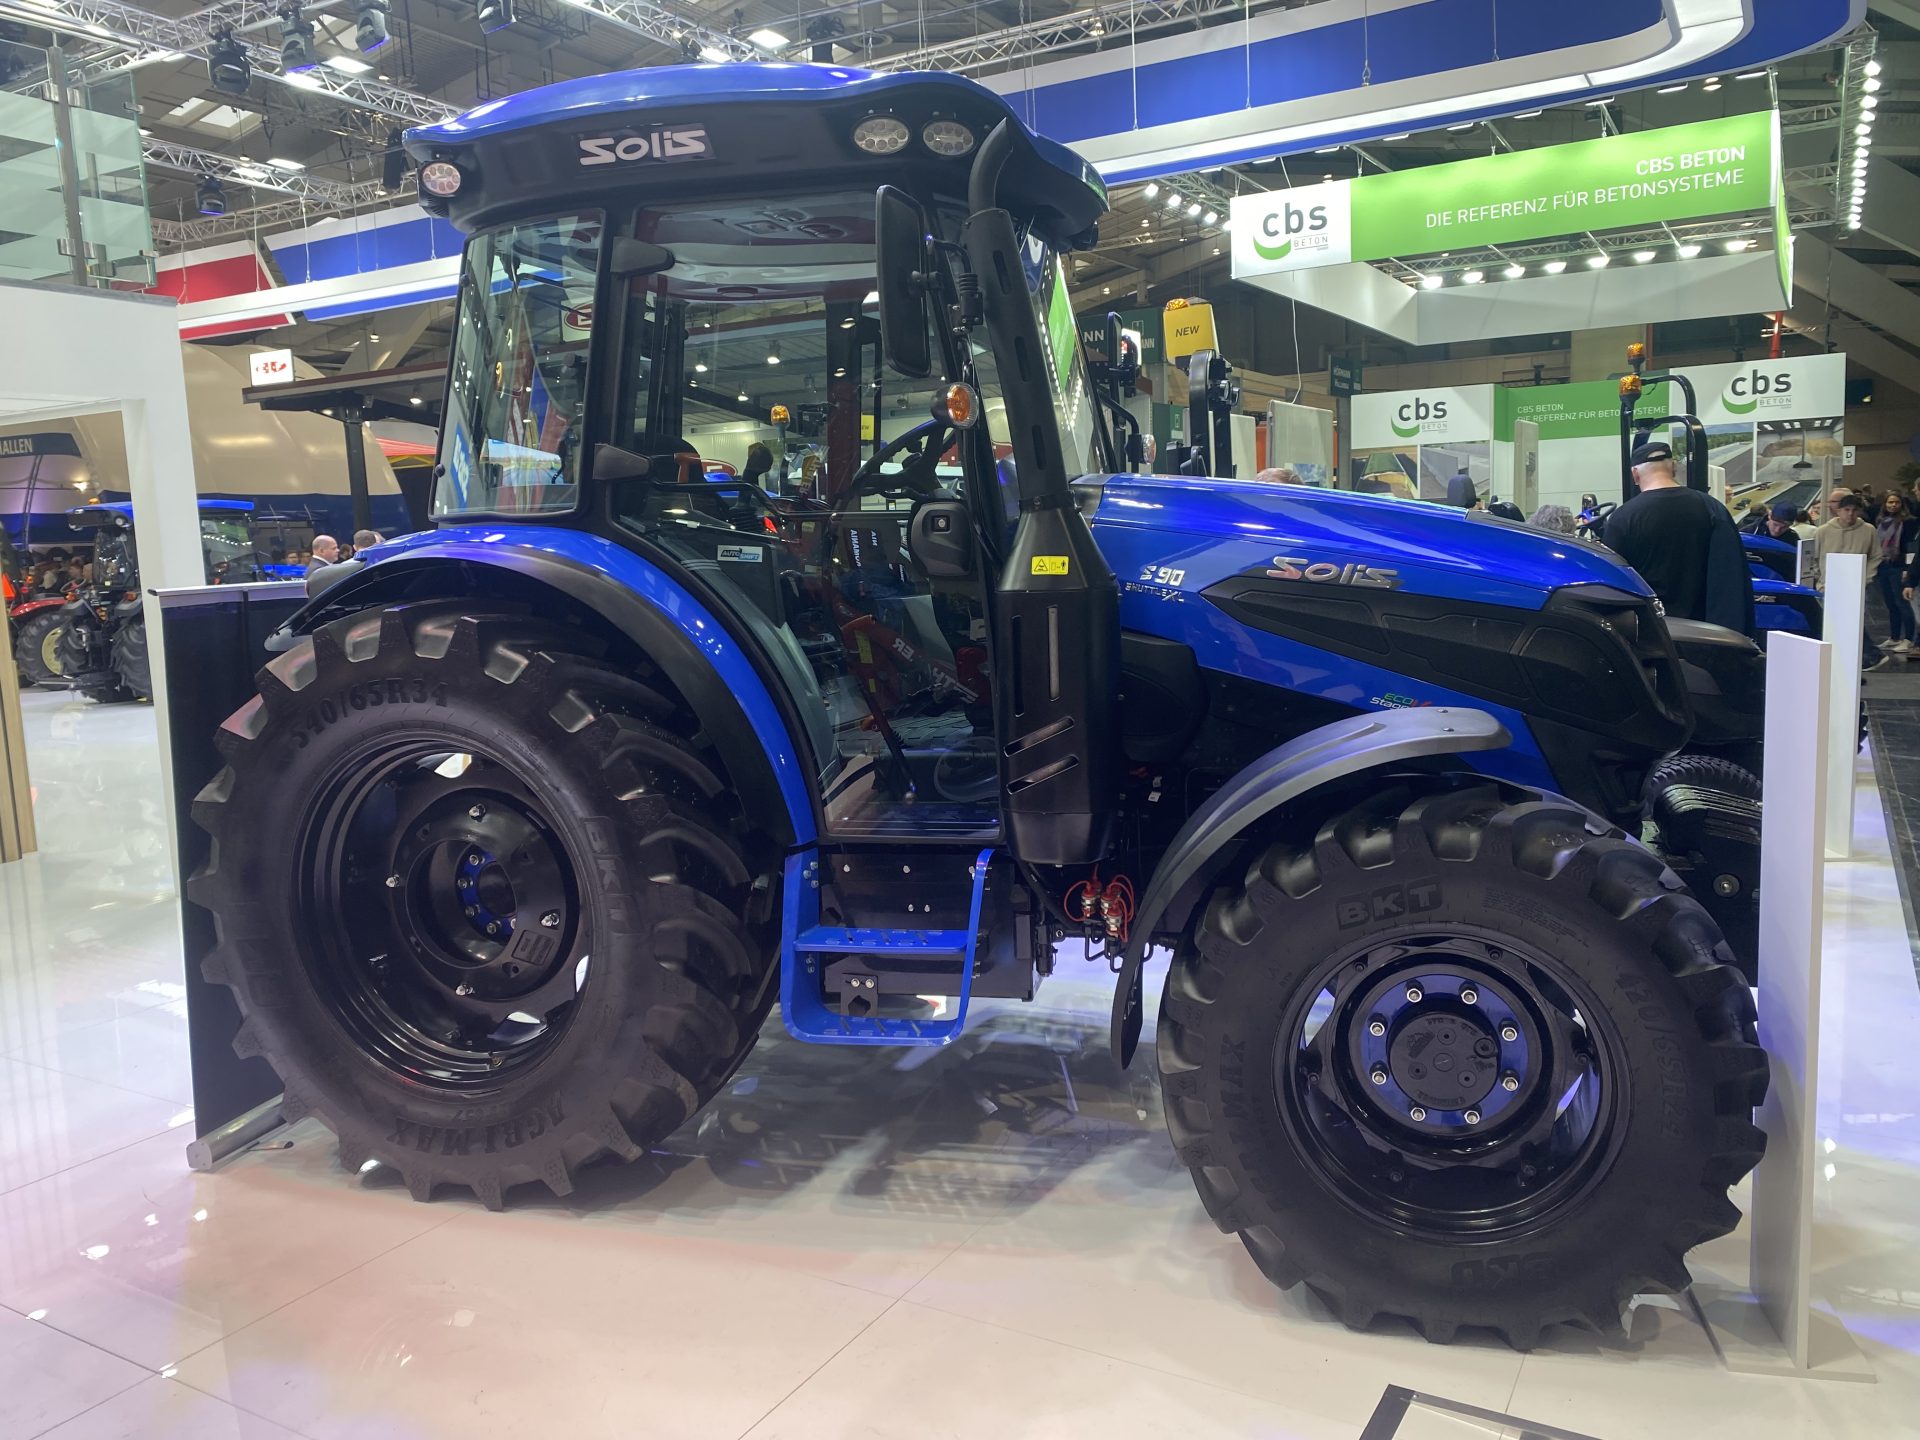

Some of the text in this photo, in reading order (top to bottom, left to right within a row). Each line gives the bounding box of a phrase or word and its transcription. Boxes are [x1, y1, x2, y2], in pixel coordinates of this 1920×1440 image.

[1636, 145, 1745, 176] CBS BETON
[1426, 168, 1745, 228] DIE REFERENZ FÜR BETONSYSTEME
[1262, 202, 1328, 237] cbs
[1293, 236, 1328, 247] BETON
[1175, 325, 1200, 337] NEW
[1731, 369, 1792, 396] cbs
[1398, 397, 1447, 422] cbs
[1517, 403, 1564, 414] CBS BETON
[1533, 412, 1577, 423] REFERENZ
[1598, 405, 1667, 418] BETOYSTEME
[1337, 877, 1442, 929] BKT
